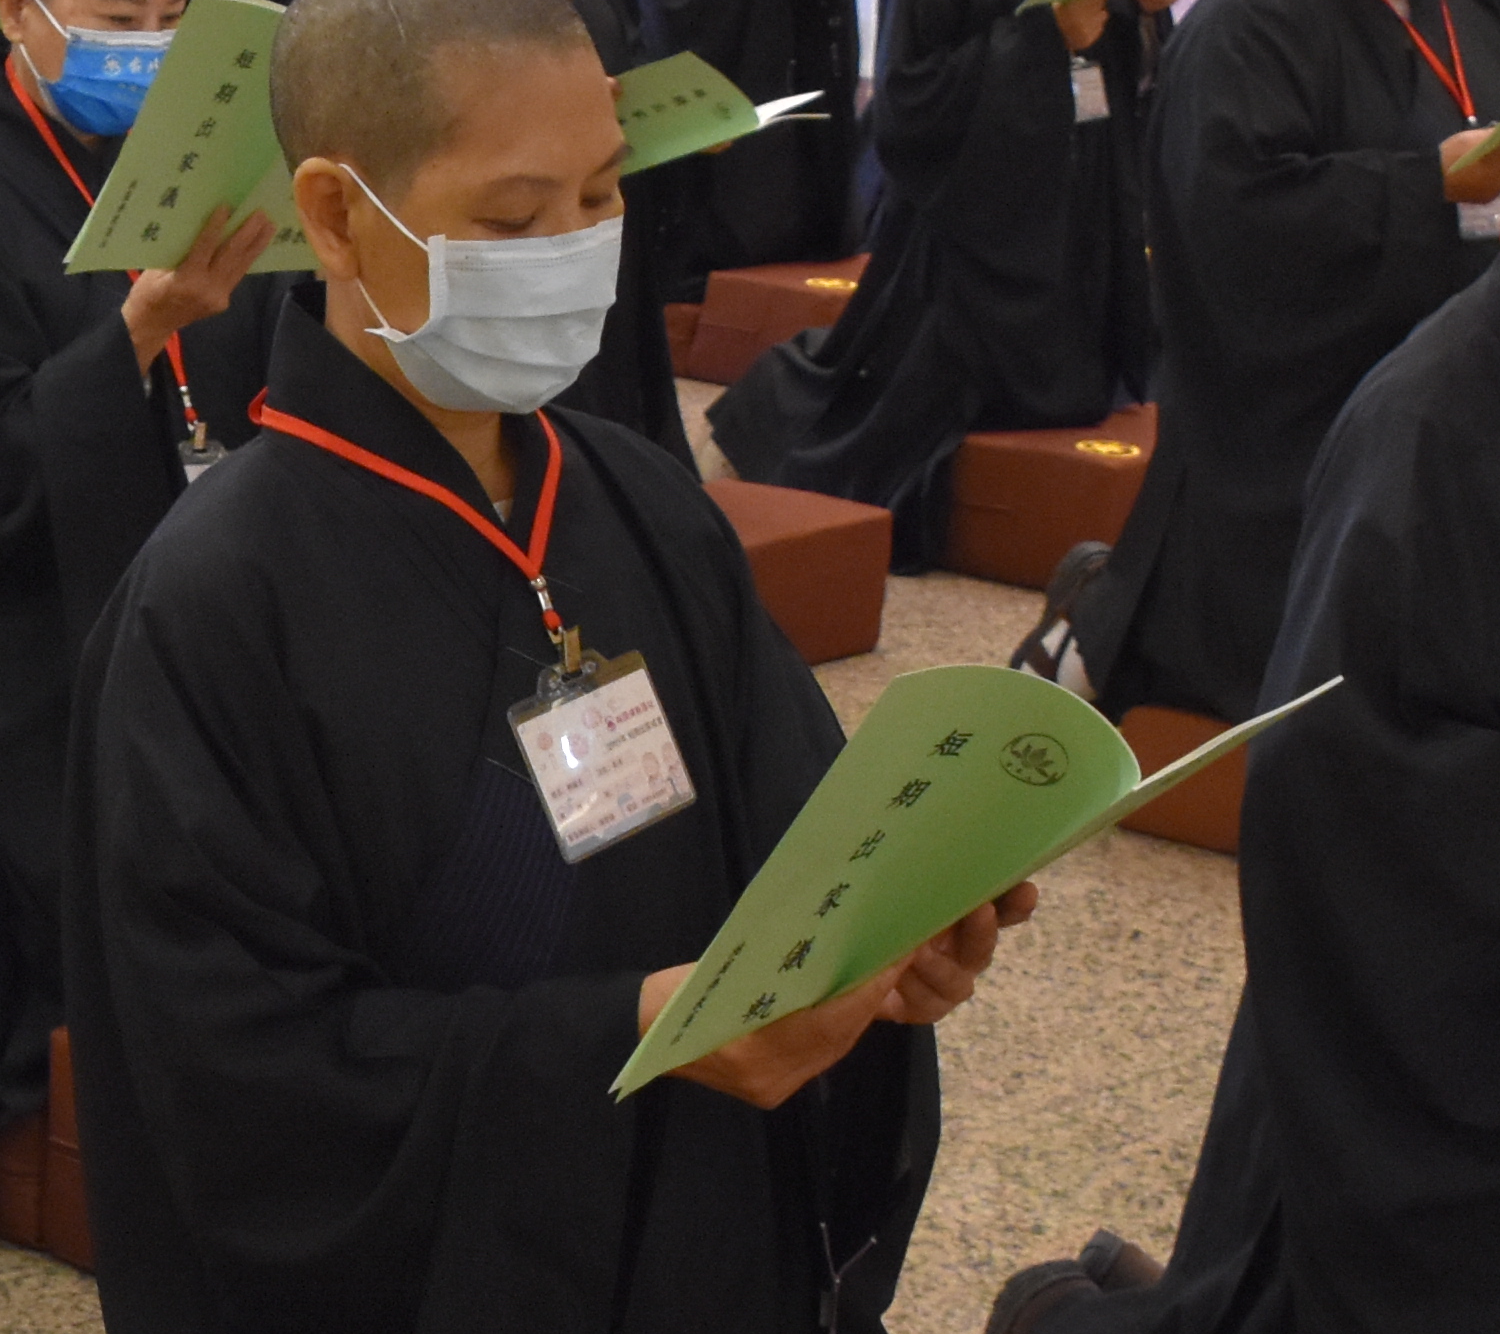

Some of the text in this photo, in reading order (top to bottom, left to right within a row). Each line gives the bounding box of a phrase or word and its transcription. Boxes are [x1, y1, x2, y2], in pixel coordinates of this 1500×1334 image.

[742, 729, 974, 1024] 短期出家儀軌
